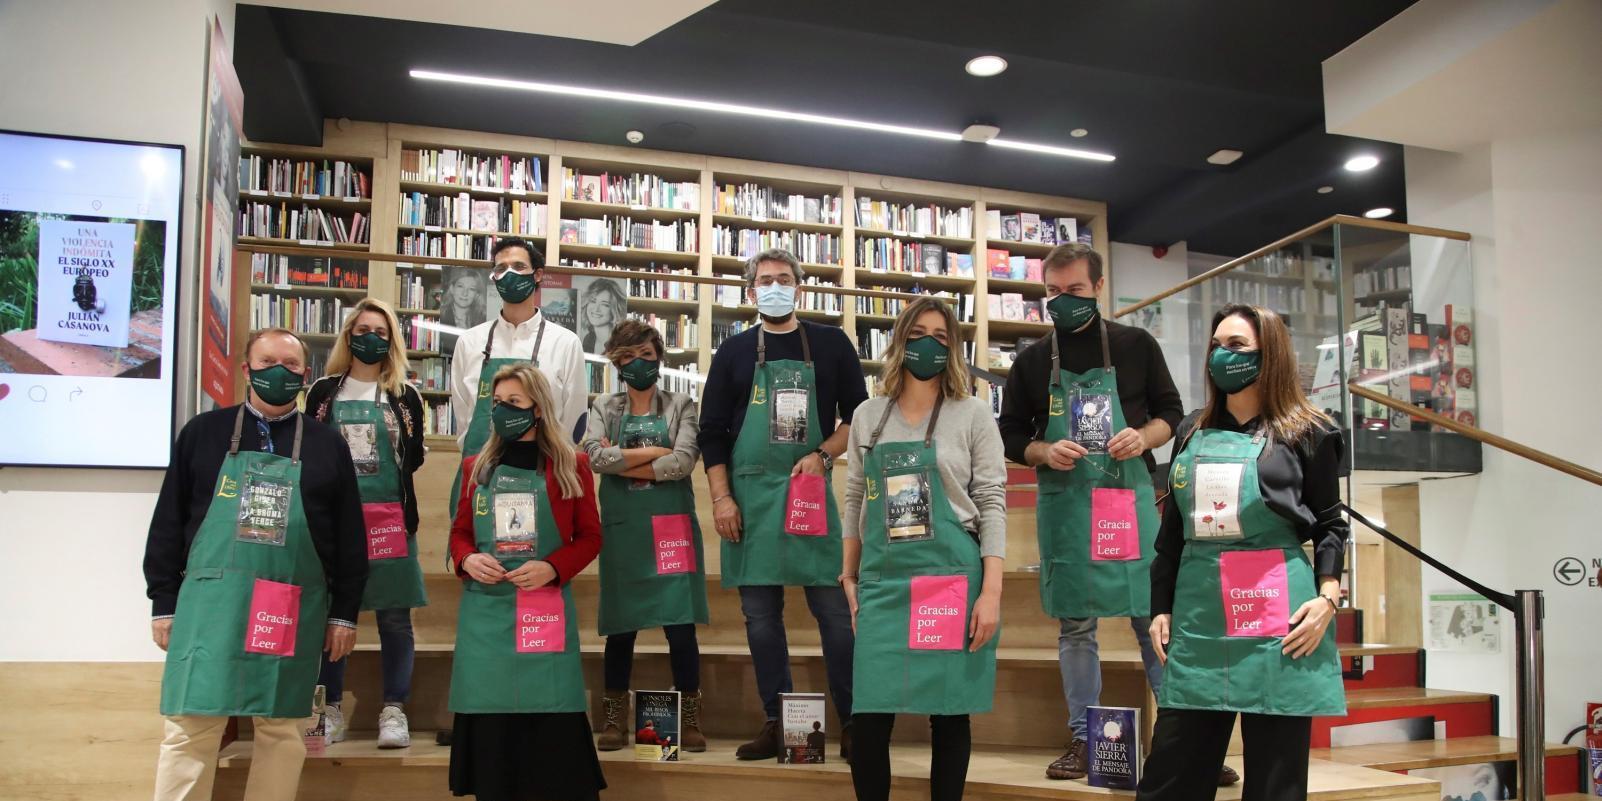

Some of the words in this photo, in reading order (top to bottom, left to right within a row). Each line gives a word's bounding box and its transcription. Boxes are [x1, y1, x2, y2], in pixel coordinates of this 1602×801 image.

[78, 228, 98, 237] UNA
[62, 237, 114, 248] VIOLENCIA
[58, 256, 70, 265] EL
[71, 257, 100, 268] SIGLO
[102, 259, 115, 268] XX
[63, 266, 109, 278] EUROPEO
[68, 311, 101, 322] JULIÁN
[58, 320, 110, 333] CASANOVA
[791, 510, 807, 519] por
[370, 525, 402, 535] Gracias
[789, 519, 810, 531] Leer
[371, 536, 387, 546] por
[1097, 531, 1116, 542] por
[373, 546, 393, 556] Leer
[660, 550, 676, 560] por
[1097, 544, 1121, 555] Leer
[662, 561, 682, 570] Leer
[1230, 587, 1280, 599] Gracias
[918, 604, 959, 616] Gracias
[1231, 602, 1254, 614] por
[256, 611, 293, 625] Gracias
[522, 613, 559, 623] Gracias
[253, 624, 274, 634] por
[917, 619, 937, 630] por
[1233, 618, 1262, 630] Leer
[522, 625, 540, 636] por
[251, 636, 276, 650] Leer
[522, 638, 546, 648] Leer
[917, 632, 943, 643] Leer
[1094, 741, 1127, 752] JAVIER
[1095, 751, 1128, 761] SIERRA
[1101, 765, 1132, 775] PANDORA
[1102, 760, 1130, 769] MENSAJE
